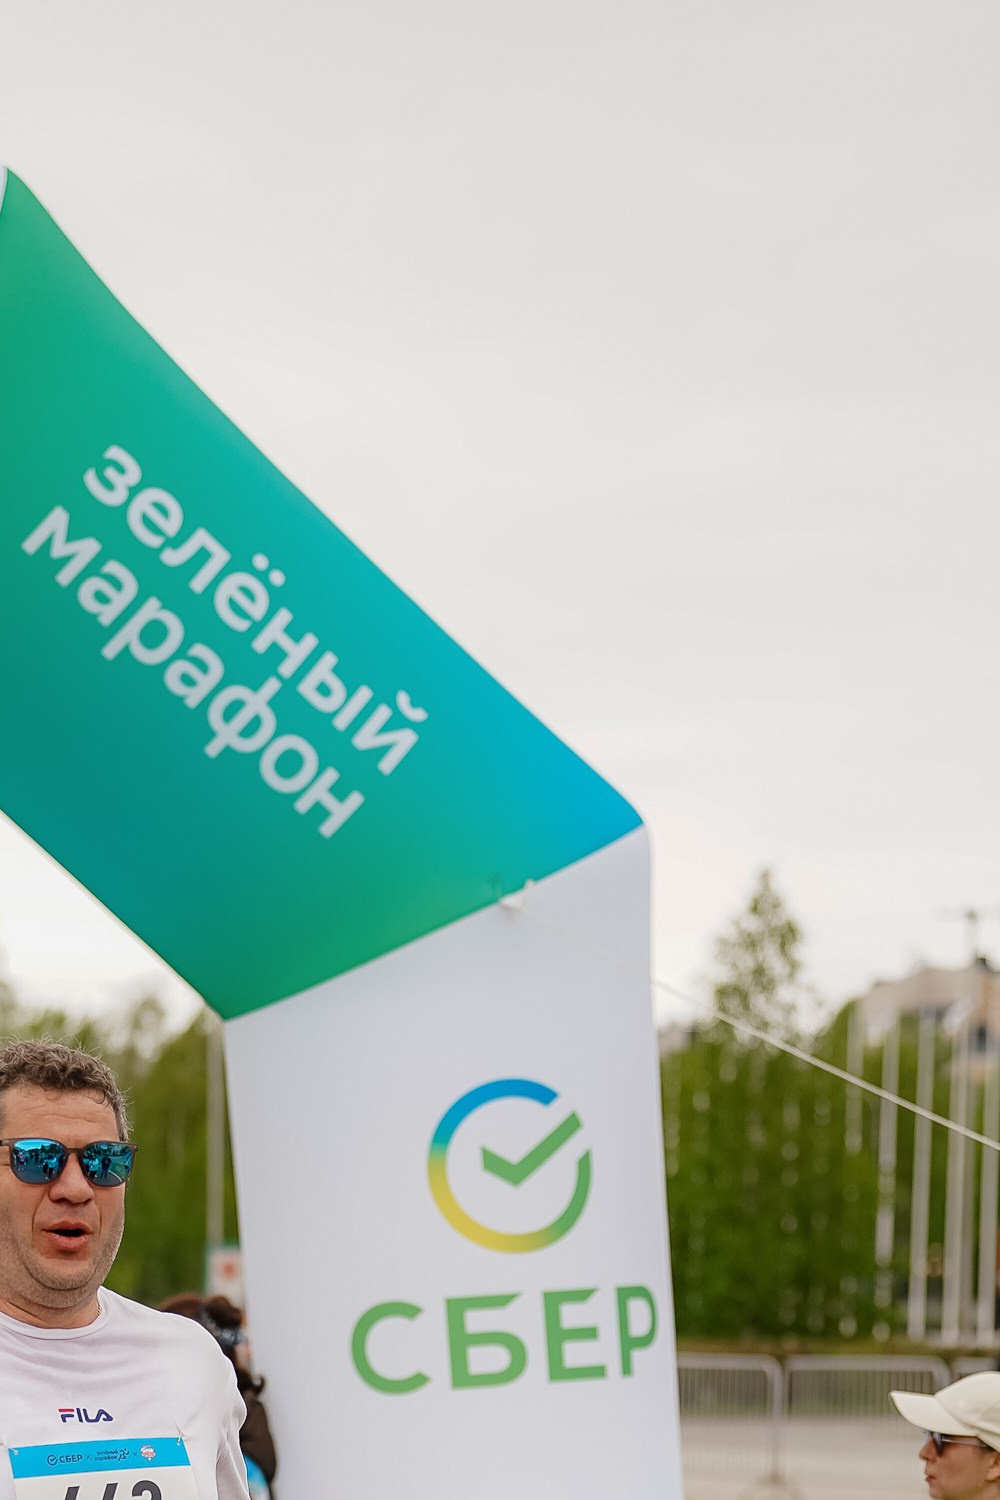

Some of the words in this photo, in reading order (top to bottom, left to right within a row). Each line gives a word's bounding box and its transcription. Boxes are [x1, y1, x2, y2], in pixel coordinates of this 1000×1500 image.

[83, 444, 428, 776] зелёный
[21, 505, 365, 838] марафон
[351, 1284, 658, 1395] СБЕР
[58, 1407, 114, 1424] FILA
[59, 1454, 83, 1464] СБЕР
